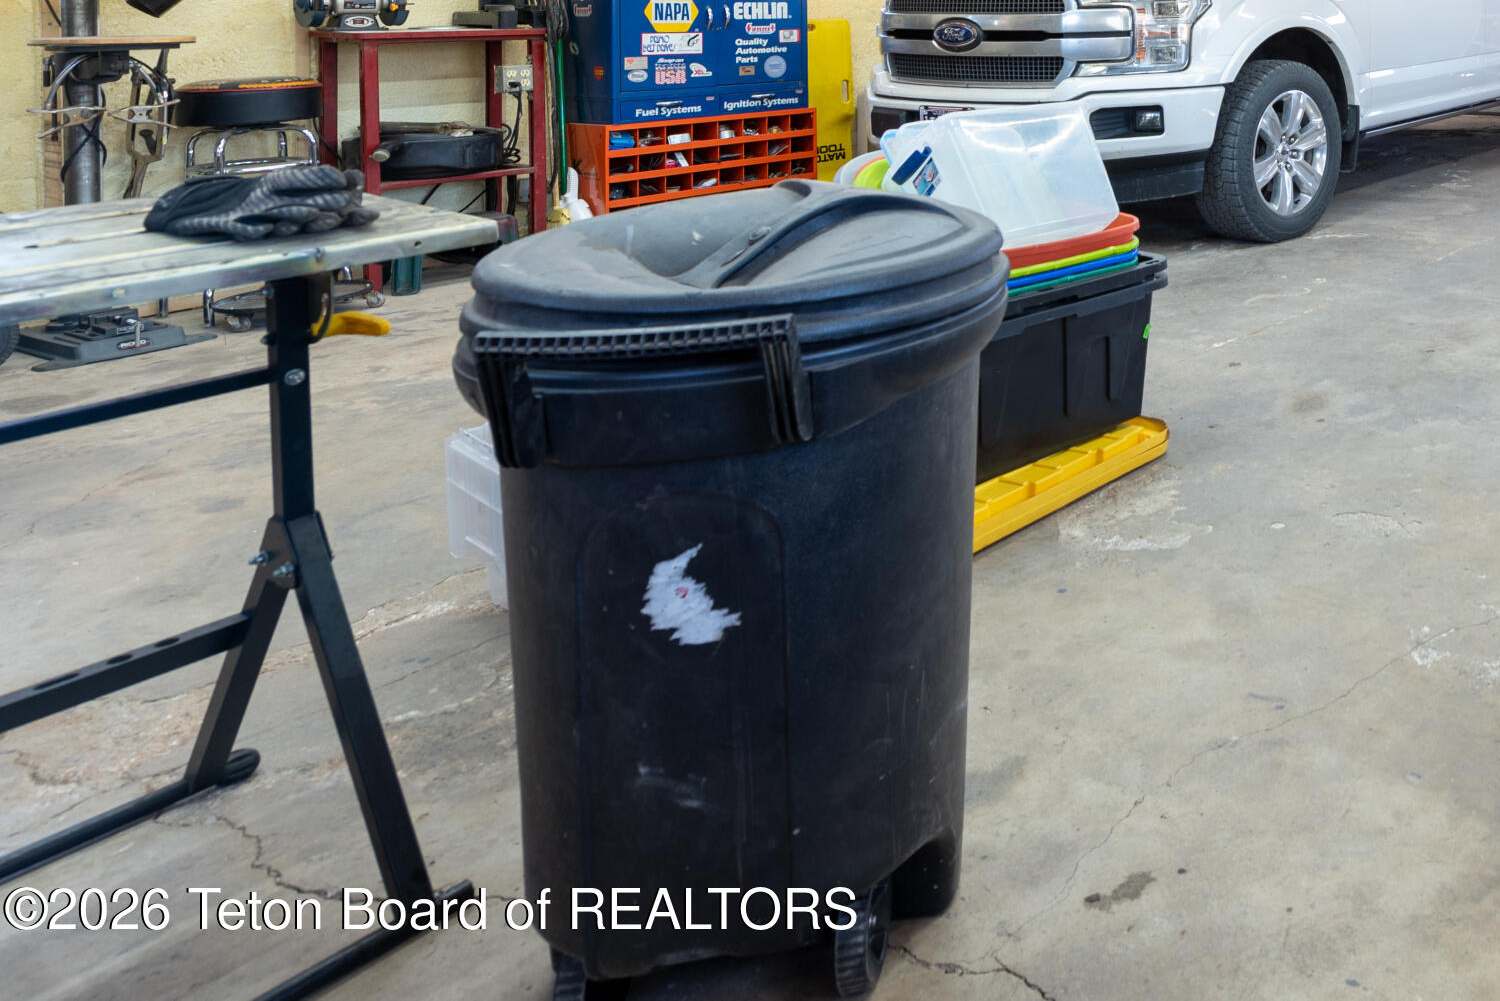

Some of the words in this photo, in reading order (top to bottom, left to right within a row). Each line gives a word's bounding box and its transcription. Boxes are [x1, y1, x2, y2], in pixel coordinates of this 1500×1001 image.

[654, 3, 690, 21] NAPA
[733, 2, 789, 20] ECHLIN
[942, 26, 967, 41] Ford
[735, 38, 769, 47] Quality
[735, 46, 788, 55] Automotive
[735, 56, 759, 64] Parts
[723, 100, 762, 112] Ignition
[762, 96, 799, 107] Systems
[635, 107, 659, 118] Fuel
[661, 105, 702, 117] Systems
[817, 143, 845, 154] TOO
[817, 151, 846, 164] MATC
